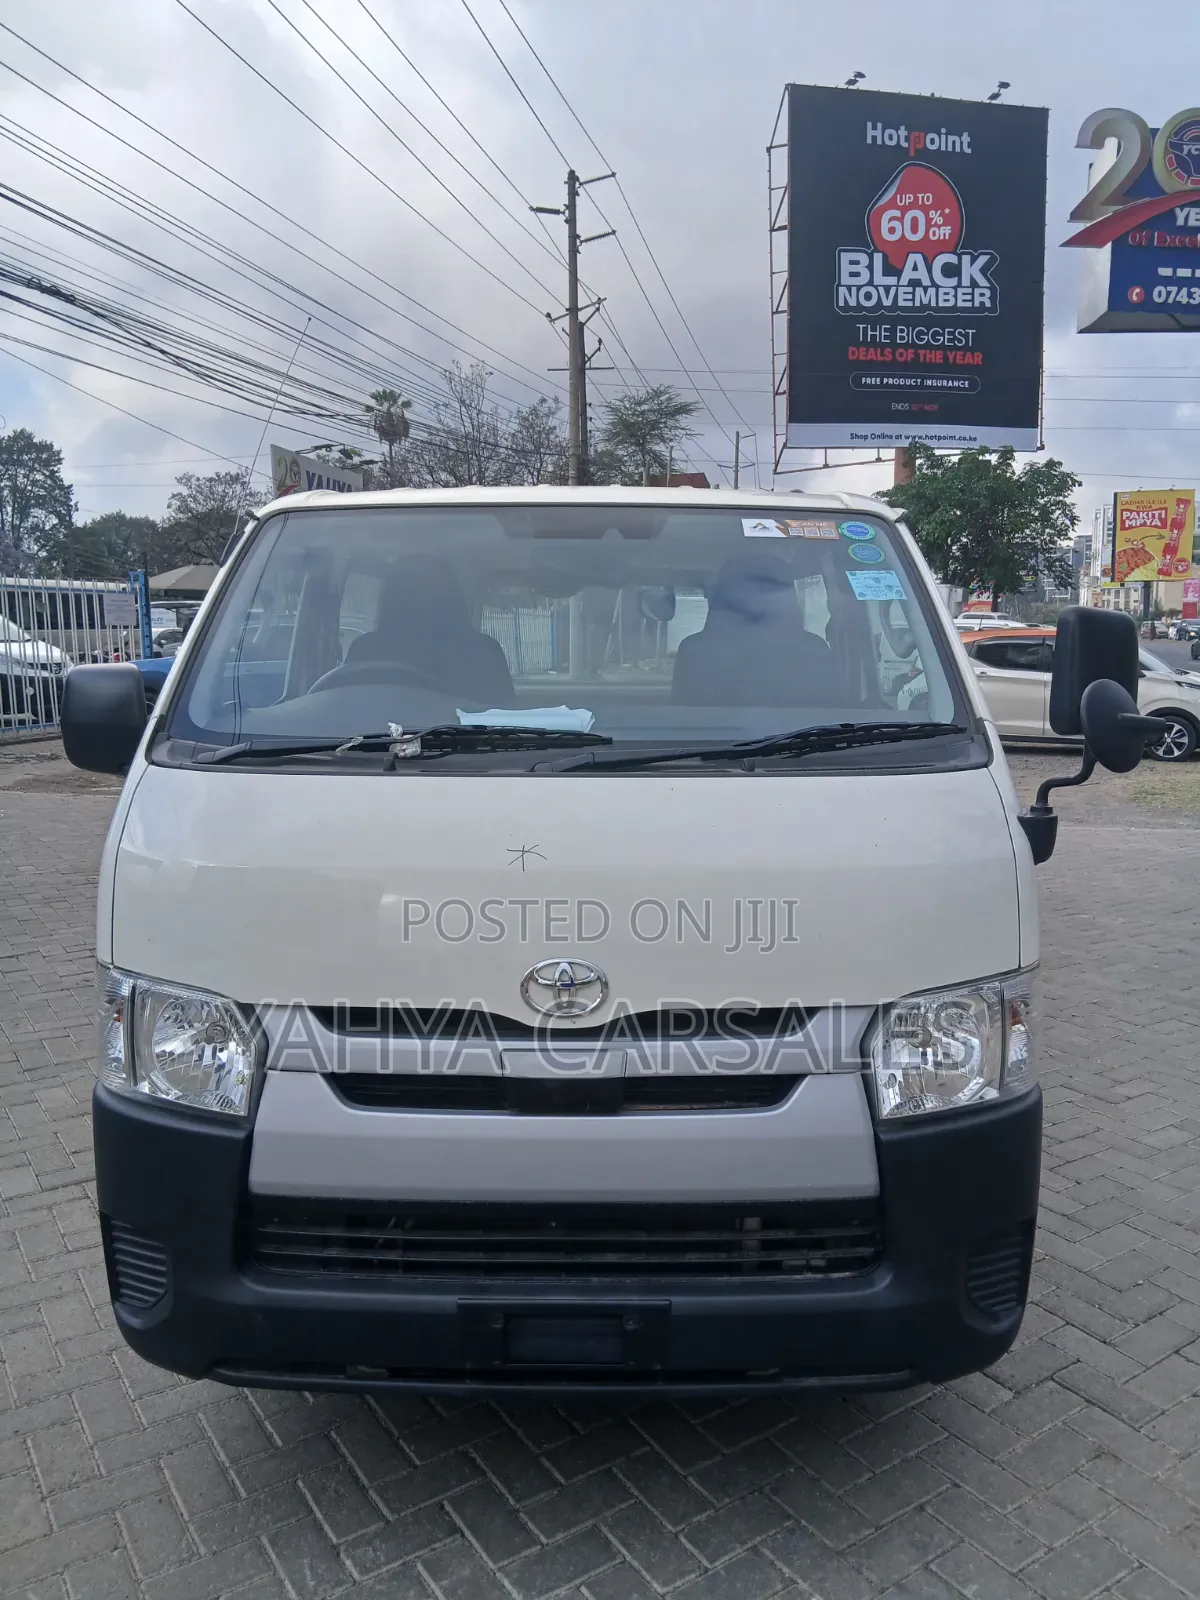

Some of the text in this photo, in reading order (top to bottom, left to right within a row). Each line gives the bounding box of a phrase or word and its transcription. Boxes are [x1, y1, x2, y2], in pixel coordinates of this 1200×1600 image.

[866, 121, 972, 156] Hotpoint
[896, 193, 933, 206] UP TO
[880, 209, 926, 241] 60
[928, 226, 951, 241] Off
[839, 252, 993, 287] BLACK
[837, 286, 992, 308] NOVEMBER
[1152, 285, 1200, 305] 0743
[856, 324, 976, 347] THE BIGGEST
[848, 346, 983, 365] DEALS OF THE YEAR
[861, 377, 970, 388] FREE PRODUCT INSURANCE
[891, 402, 910, 411] ENDS
[849, 432, 978, 443] Shop Online at www.hotpoint.co.ke
[1122, 510, 1166, 520] PAKITI
[1125, 518, 1162, 528] MPYA
